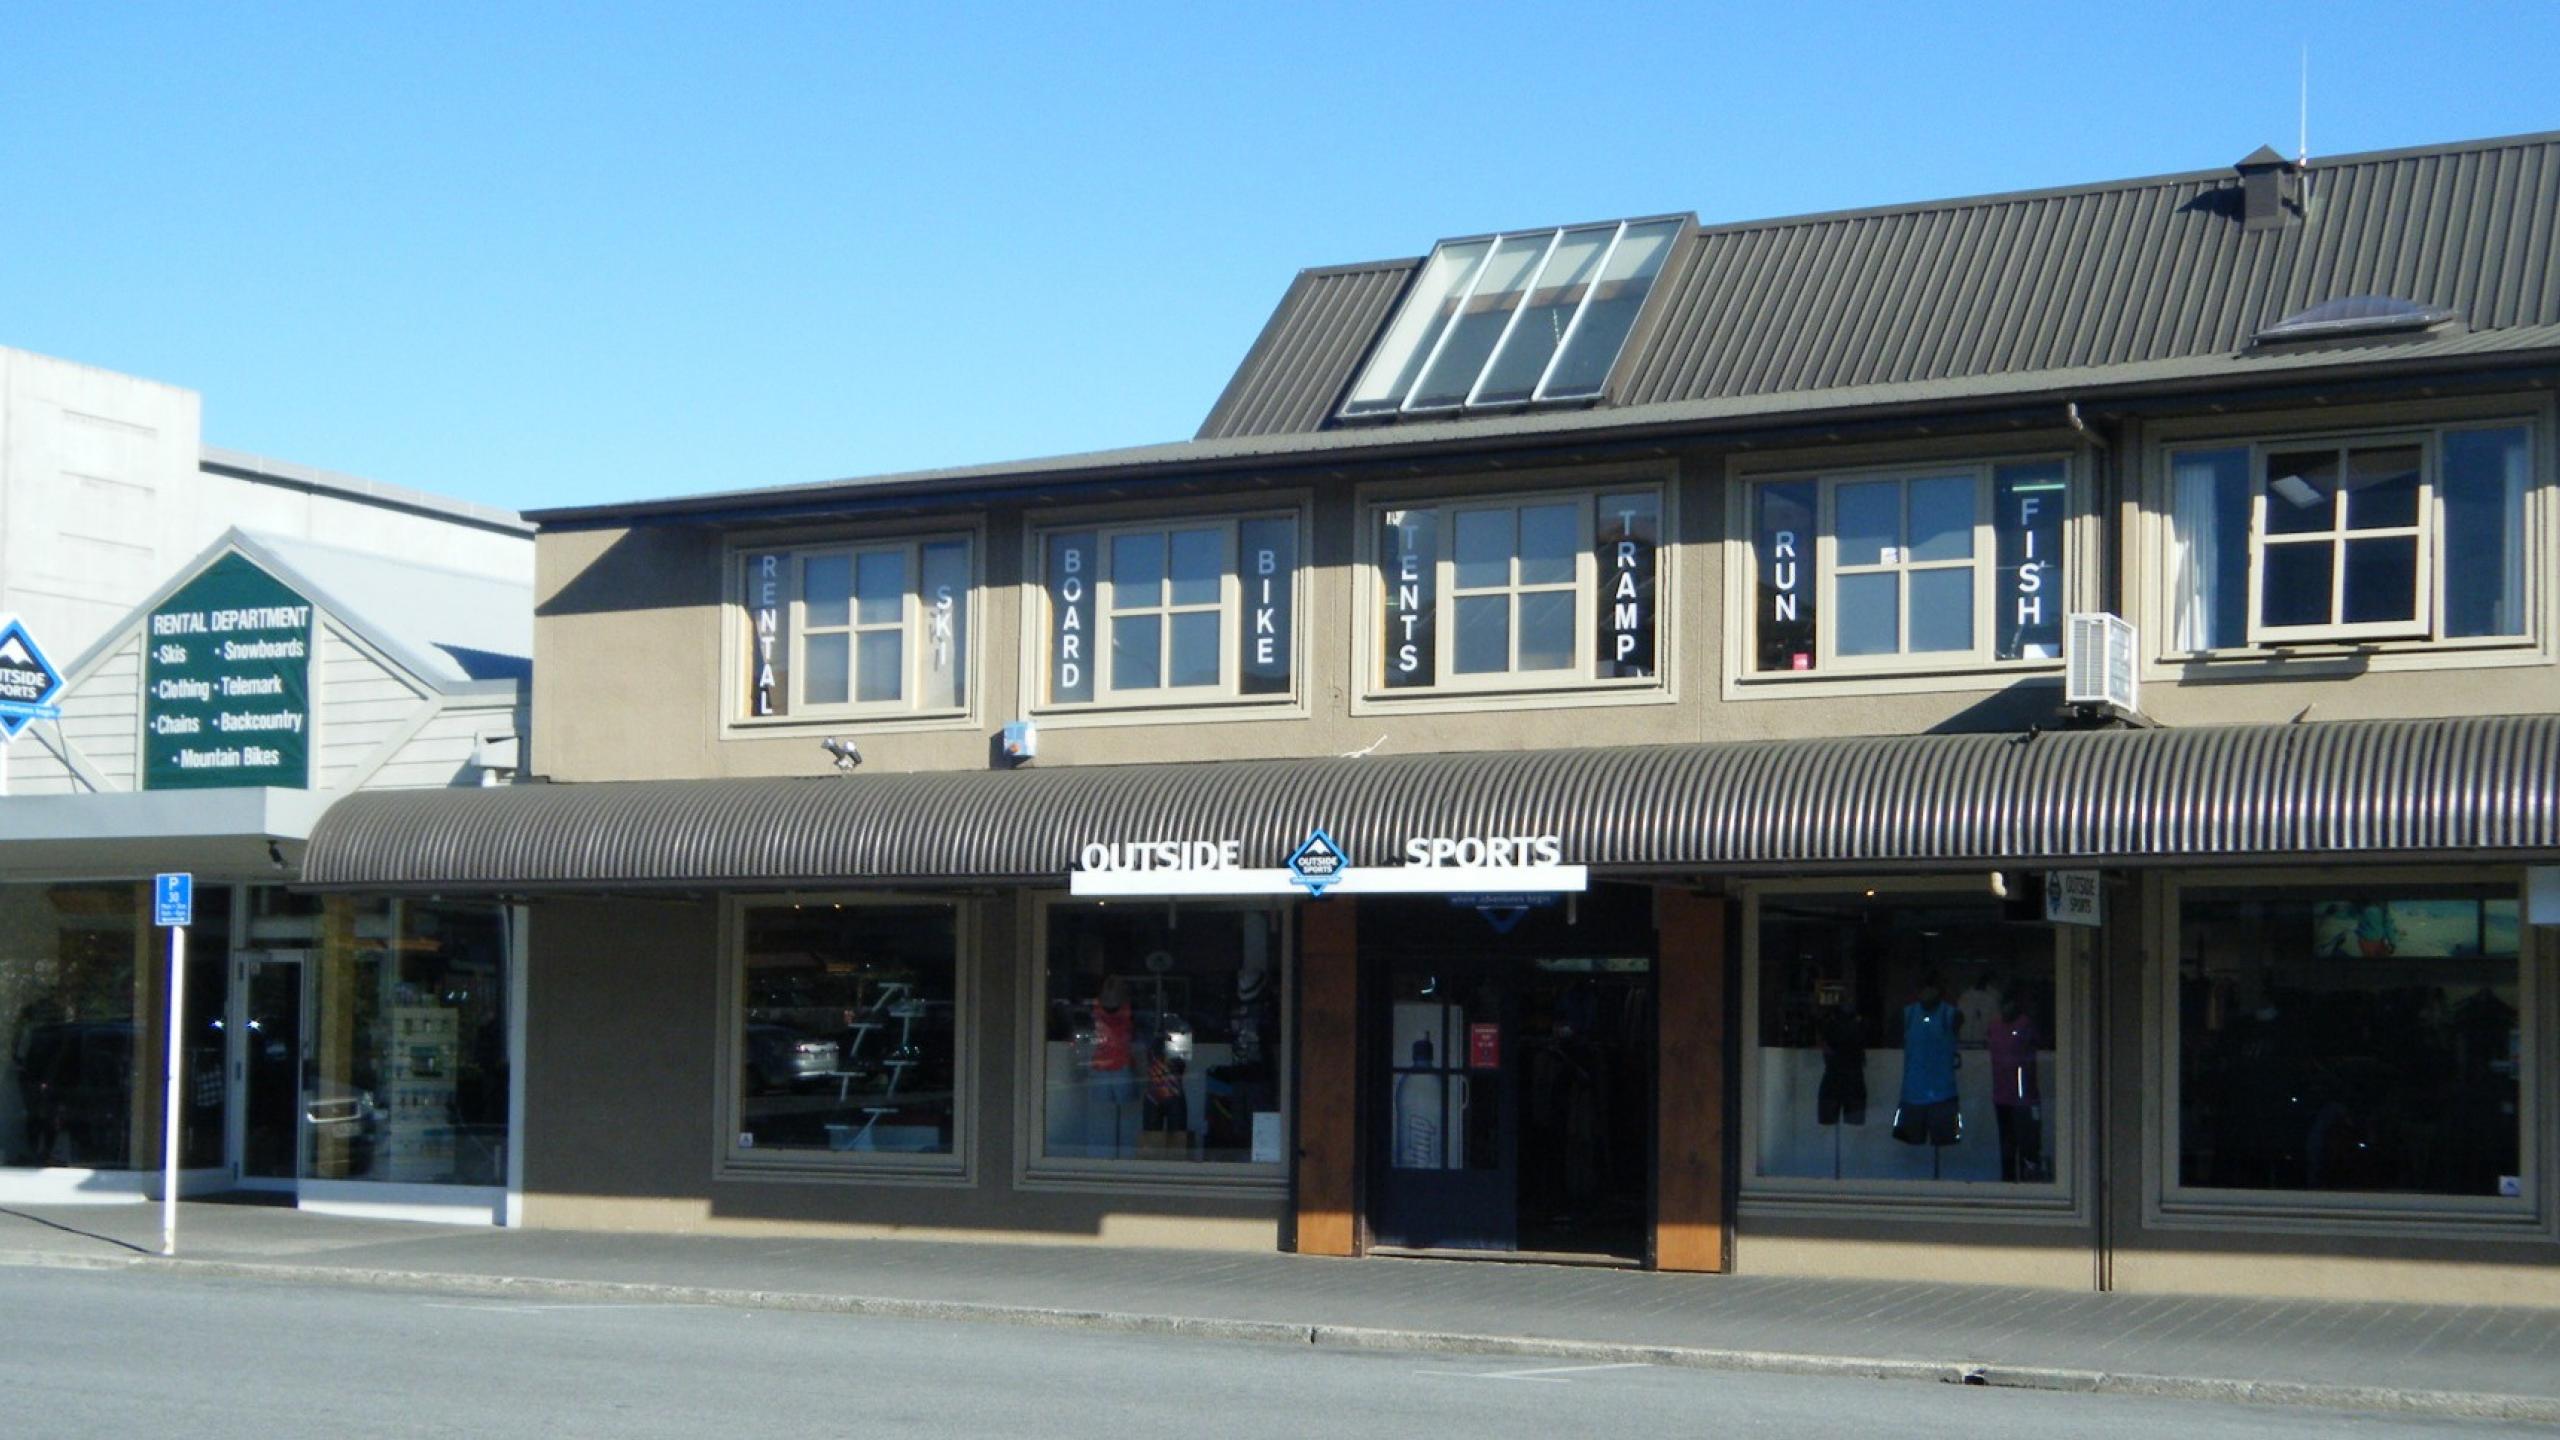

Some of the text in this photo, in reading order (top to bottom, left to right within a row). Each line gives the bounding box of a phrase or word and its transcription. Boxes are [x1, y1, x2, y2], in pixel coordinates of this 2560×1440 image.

[1775, 531, 1796, 622] RUN
[2018, 498, 2040, 625] FISH
[1399, 525, 1418, 673] TENTS
[1614, 510, 1638, 662] TRAMP
[153, 605, 309, 635] RENTAL DEPARTMENT
[1062, 548, 1082, 688] BOARD
[1256, 550, 1276, 664] BIKE
[759, 555, 777, 715] RENTAL
[936, 584, 953, 665] SKI
[159, 644, 187, 664] Skis
[224, 637, 304, 661] Snowboards
[159, 678, 210, 702] Clothing
[221, 674, 282, 695] Telemark
[157, 714, 200, 734] Chains
[221, 709, 303, 733] Backcountry
[180, 745, 280, 768] Mountain Bikes
[1080, 835, 1561, 872] OUTSIDE SPORTS
[1298, 856, 1338, 867] OUTSIDE
[168, 876, 180, 890] P
